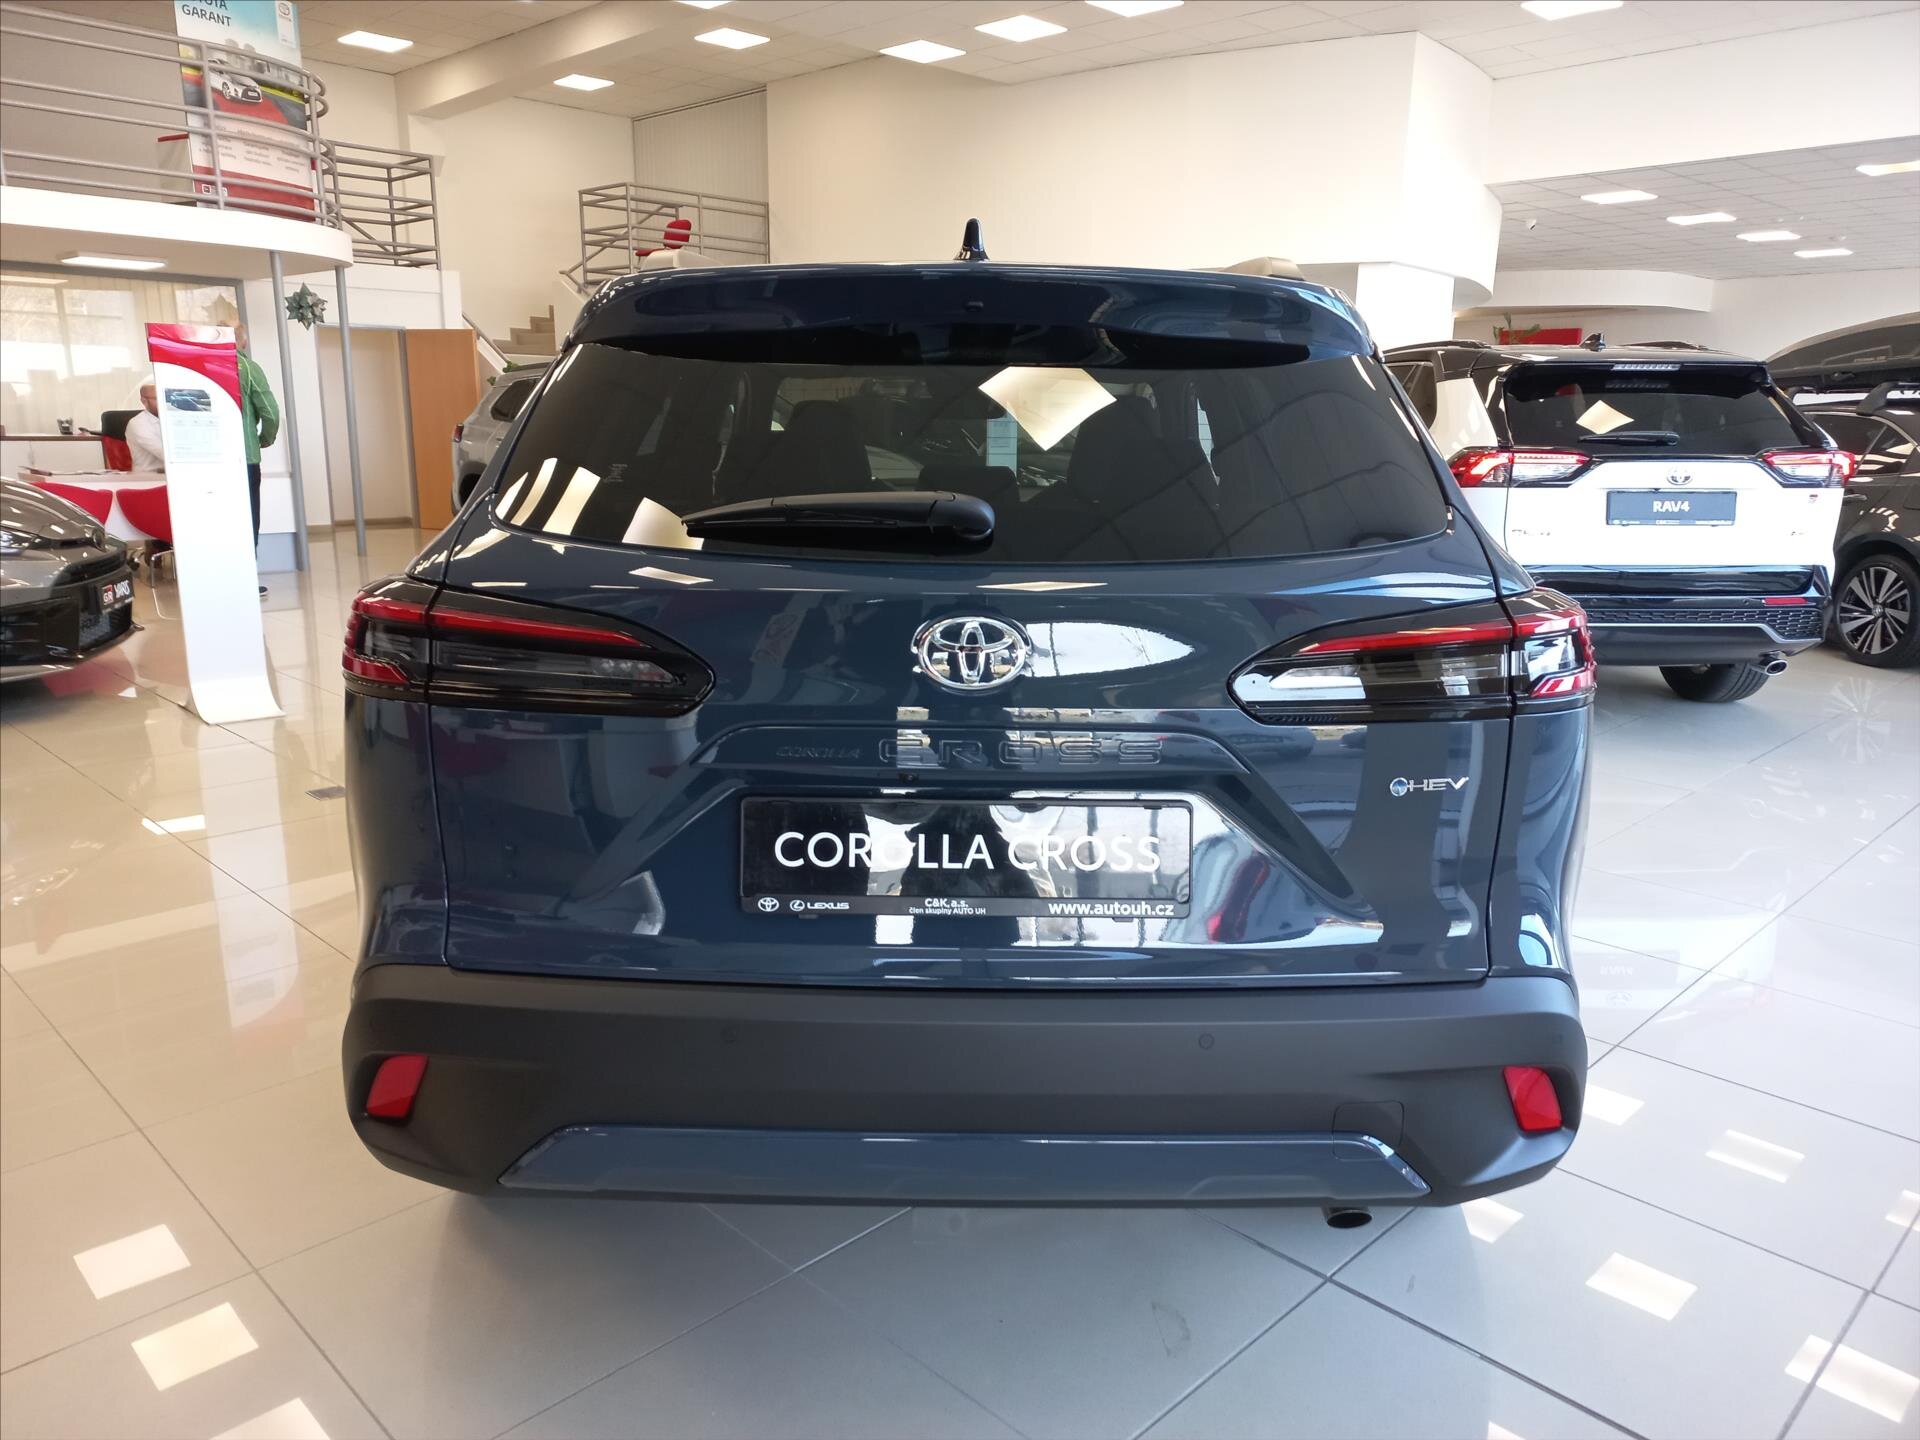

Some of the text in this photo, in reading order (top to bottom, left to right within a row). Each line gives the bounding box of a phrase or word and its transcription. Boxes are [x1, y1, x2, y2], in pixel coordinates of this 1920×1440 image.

[181, 4, 232, 27] GARANT
[1652, 500, 1690, 512] RAV4
[775, 738, 1163, 766] COROLLA CROSS
[1409, 777, 1470, 792] HEV
[774, 831, 1161, 872] COROLLA CROSS
[807, 901, 850, 910] LEXUS
[951, 899, 969, 908] a.s.
[952, 907, 974, 915] AUTO
[975, 907, 986, 915] UH
[1048, 901, 1175, 916] www.autouh.cz
